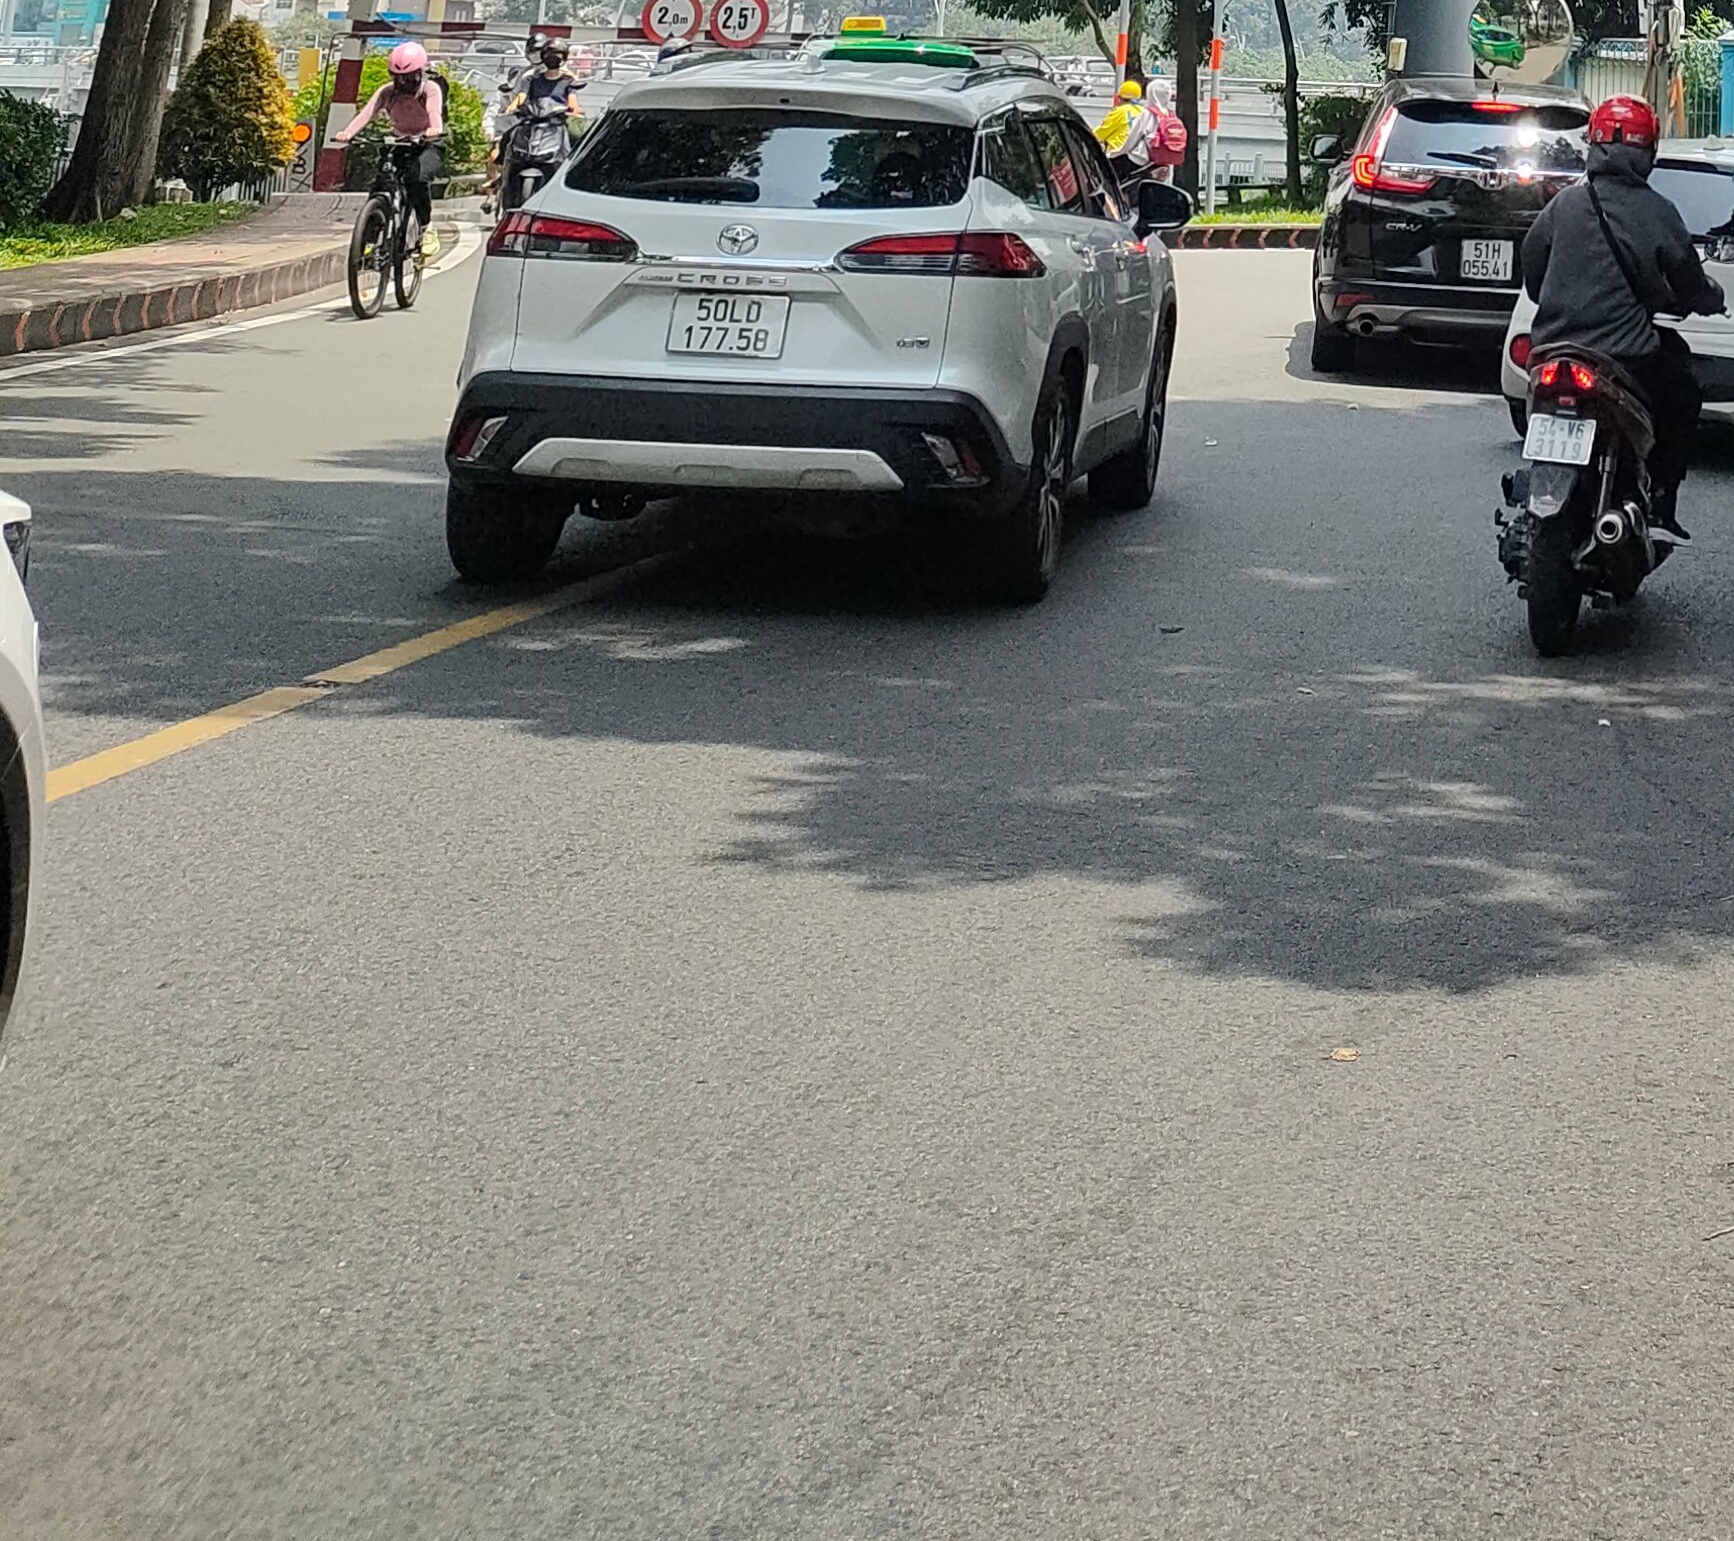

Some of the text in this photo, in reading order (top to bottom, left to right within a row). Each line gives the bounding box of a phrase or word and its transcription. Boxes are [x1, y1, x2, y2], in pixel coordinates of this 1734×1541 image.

[1474, 242, 1501, 259] 51H
[1463, 259, 1508, 278] 055.41
[677, 273, 788, 287] CROSS
[696, 298, 761, 324] 50LD
[683, 325, 769, 353] 177.58
[1534, 438, 1582, 460] 3119
